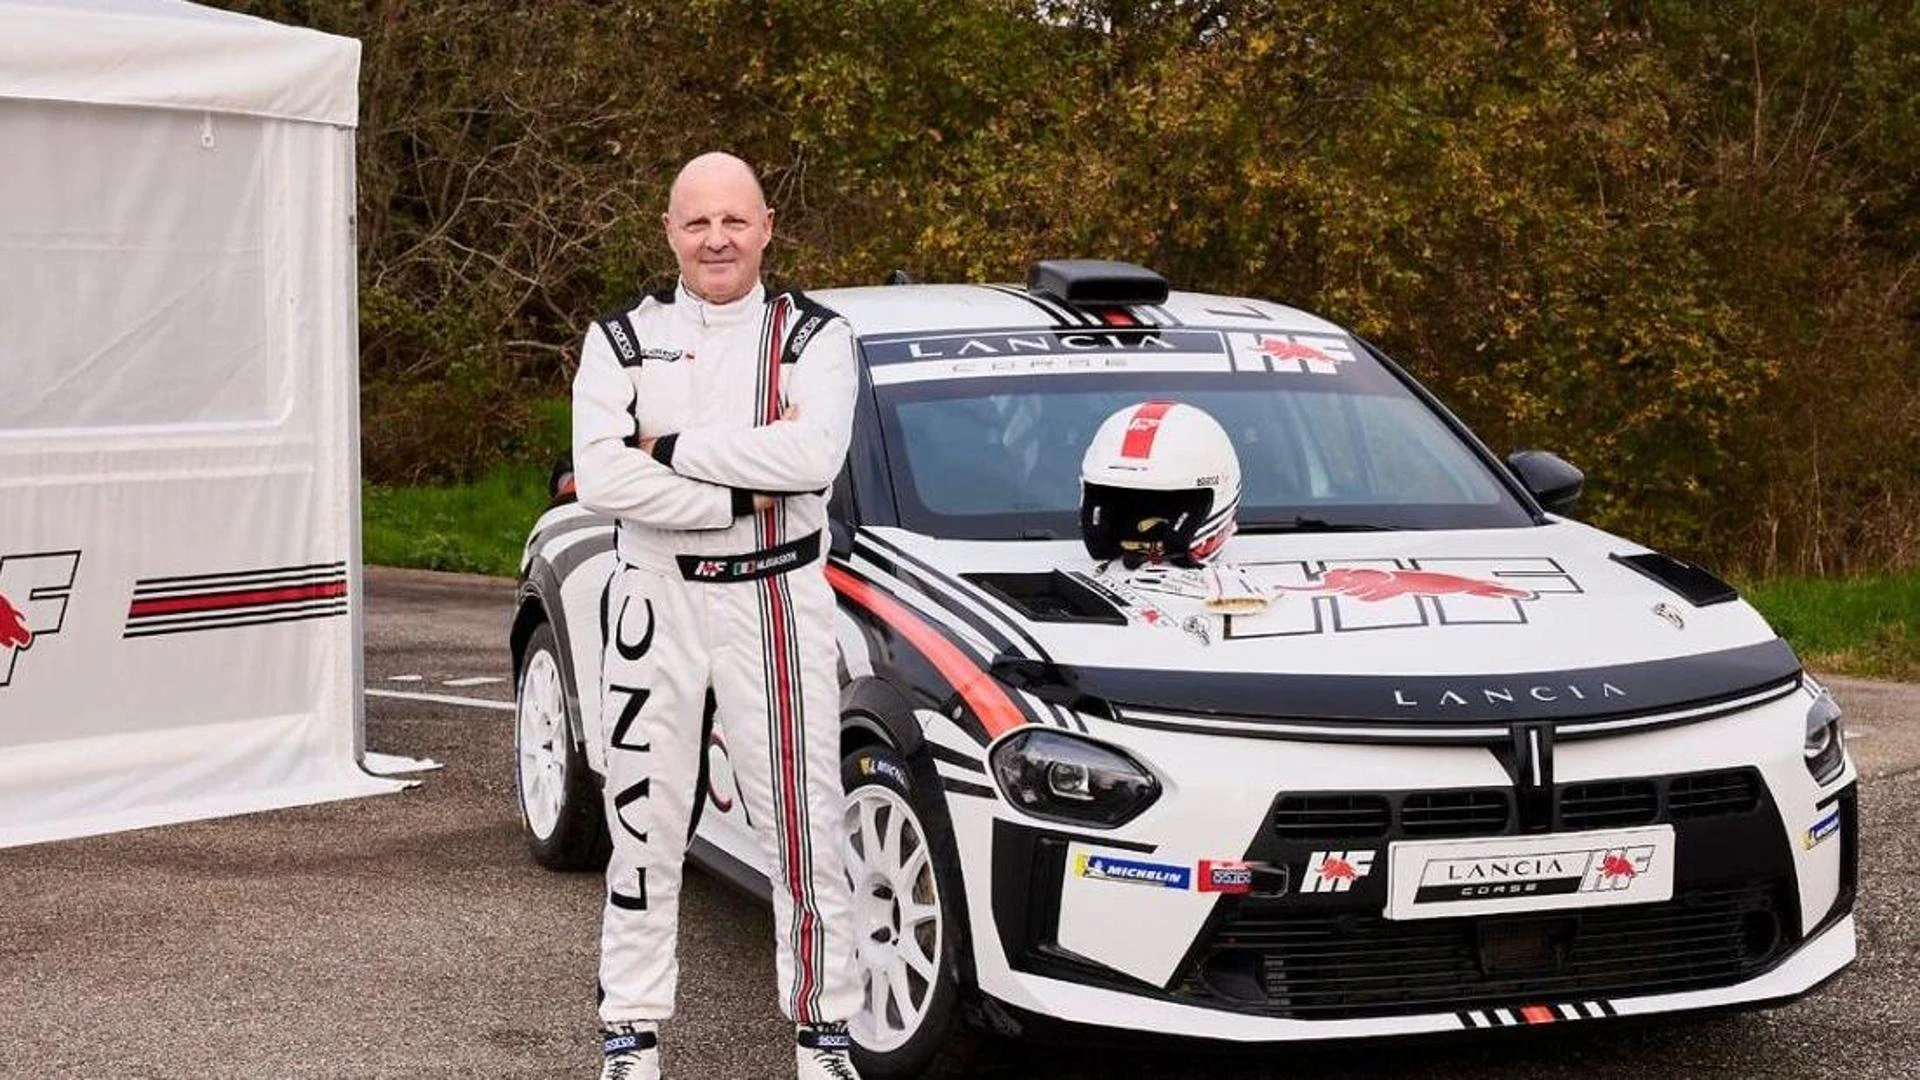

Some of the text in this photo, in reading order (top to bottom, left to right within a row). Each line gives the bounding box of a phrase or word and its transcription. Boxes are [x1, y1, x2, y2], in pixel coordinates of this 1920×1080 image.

[907, 333, 1178, 358] LANCIA
[1393, 681, 1627, 707] LANCIA
[1107, 865, 1183, 884] MICHELIN
[1299, 849, 1378, 893] HF
[1447, 858, 1564, 881] LANCIA
[1460, 883, 1539, 897] CORSE
